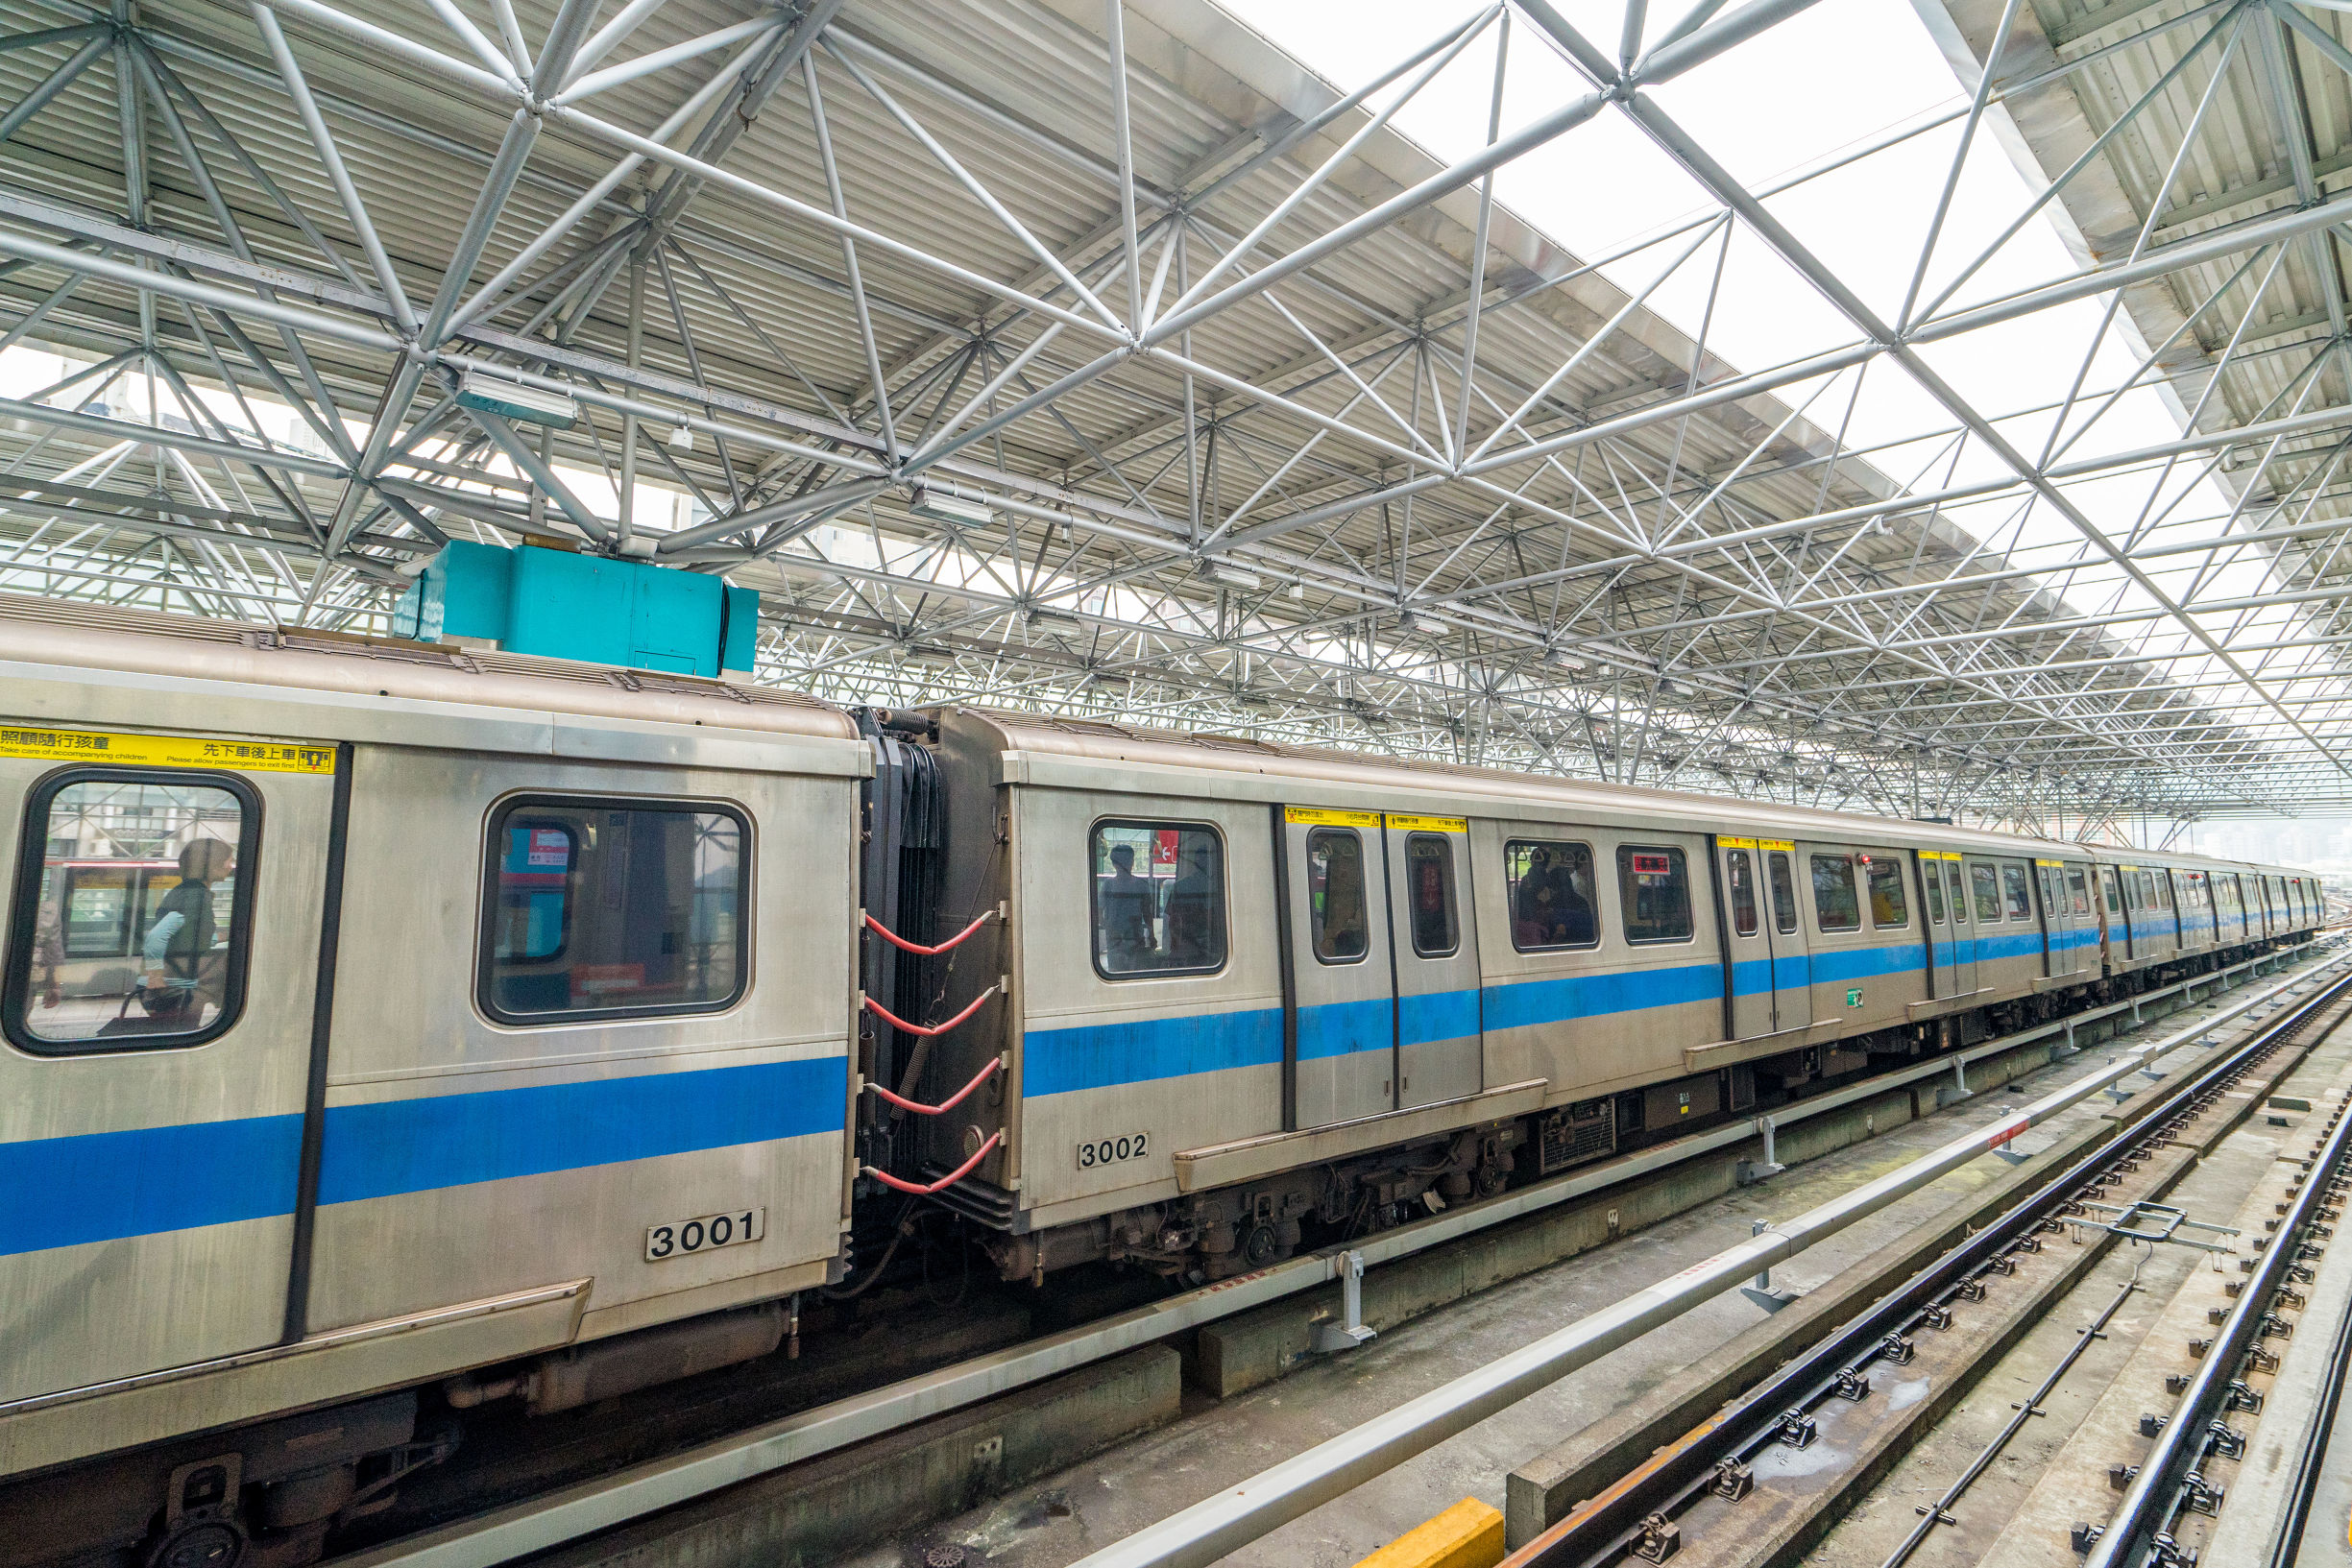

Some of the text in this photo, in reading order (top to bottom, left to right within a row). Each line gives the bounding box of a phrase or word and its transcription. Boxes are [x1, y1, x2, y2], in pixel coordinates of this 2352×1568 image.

[0, 730, 109, 750] 照顧隨行孩童
[53, 749, 113, 760] accompanying
[204, 743, 296, 760] 先下車後上車
[1081, 1134, 1146, 1167] 3002
[651, 1211, 753, 1257] 3001
